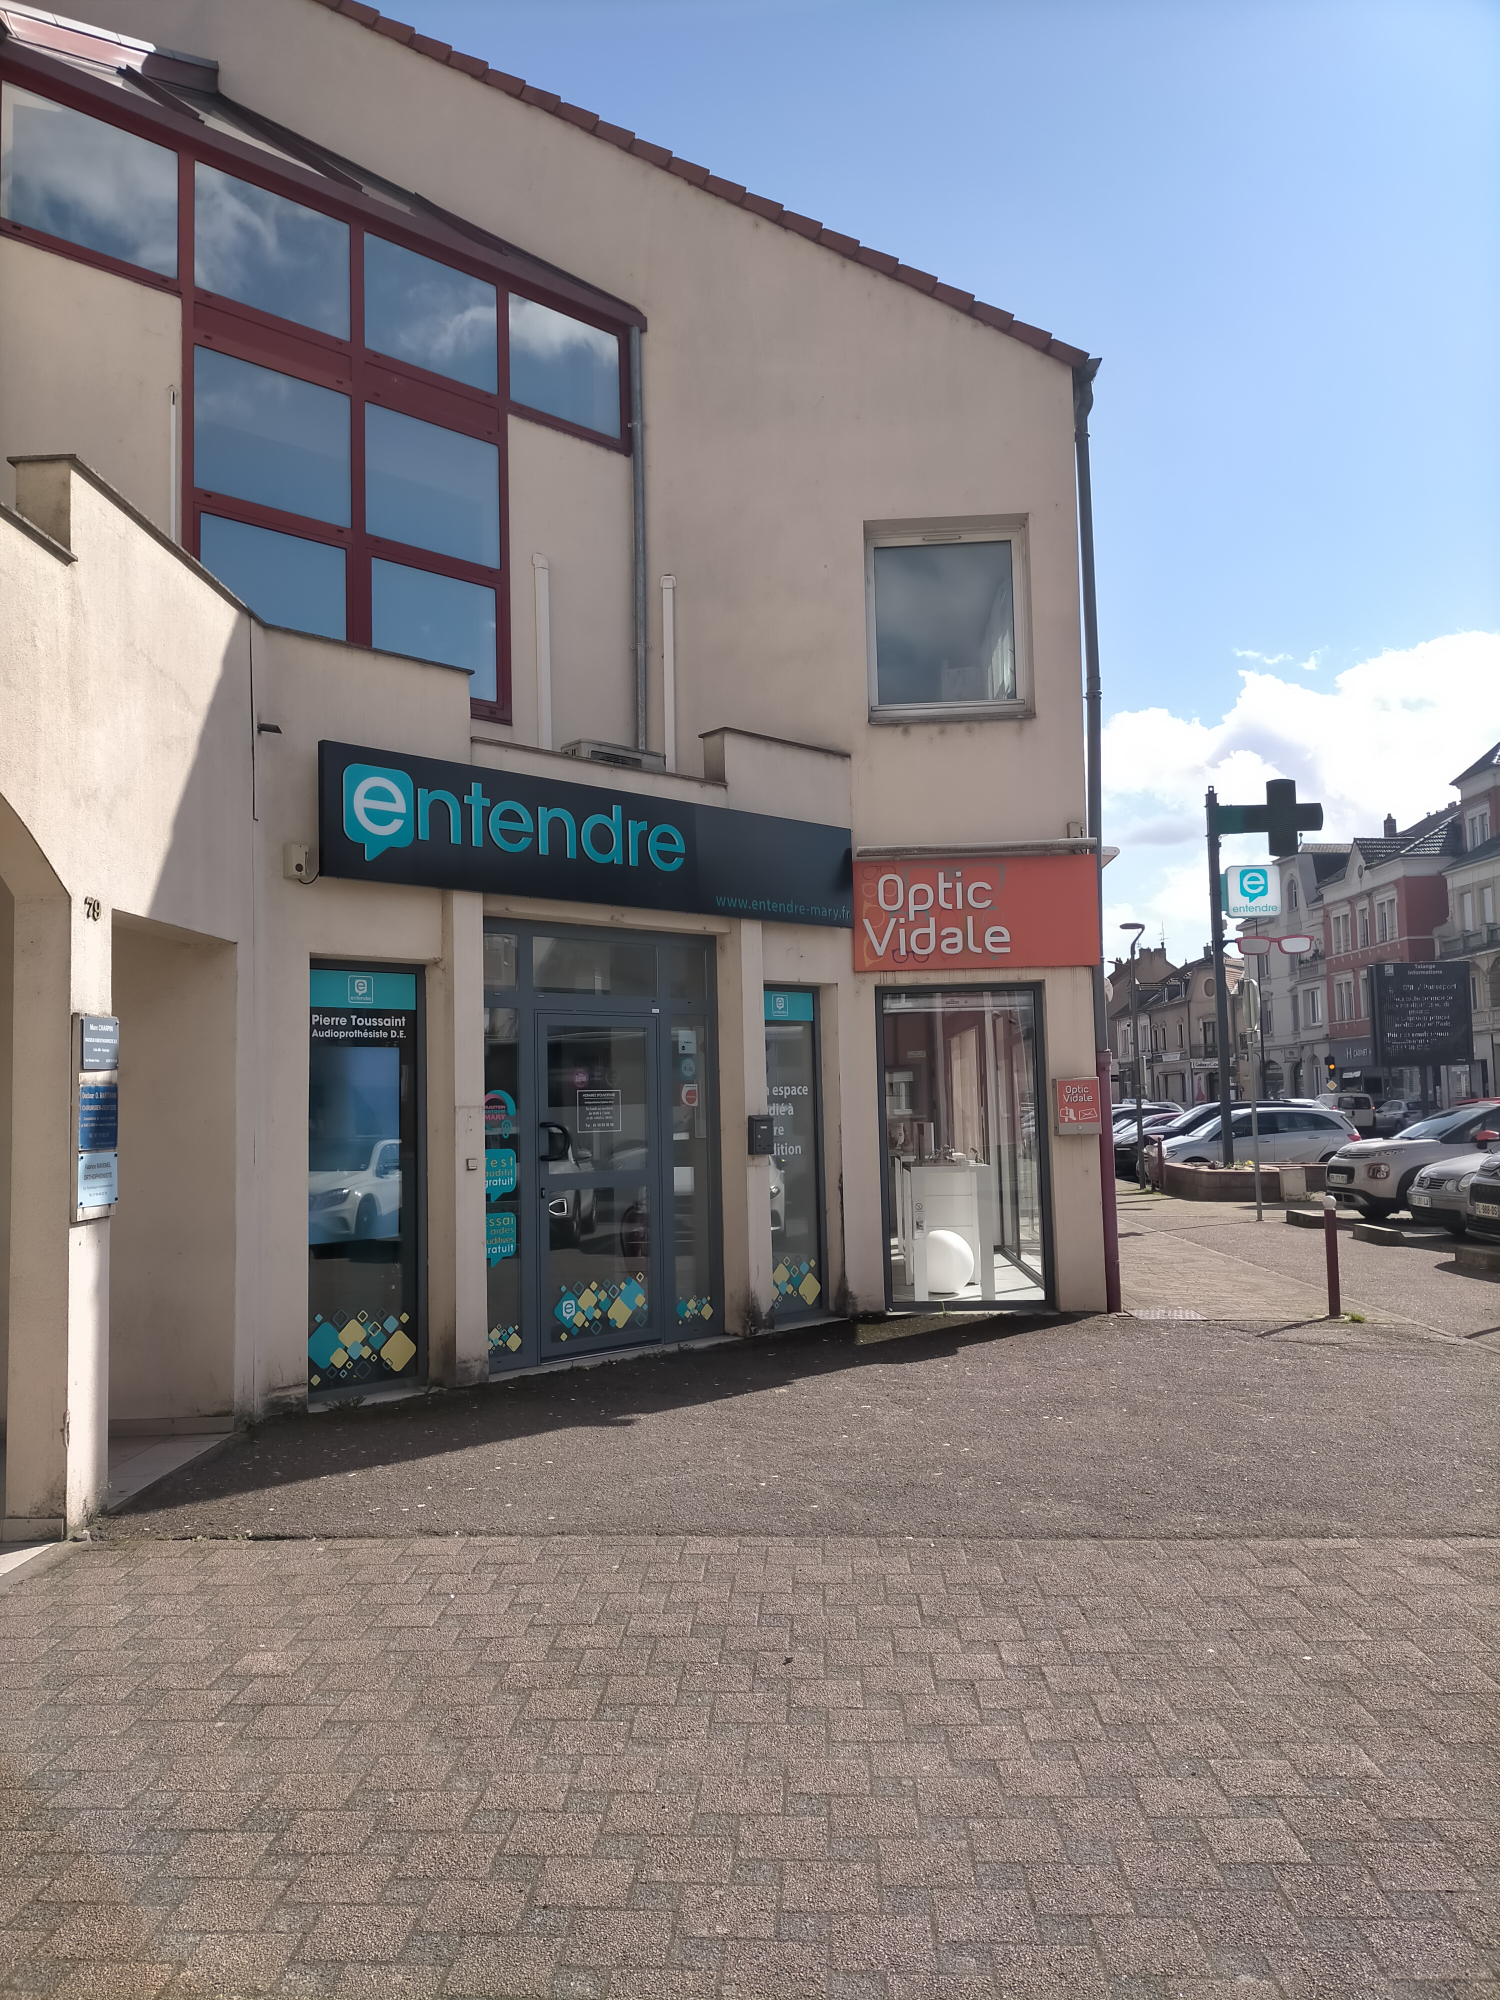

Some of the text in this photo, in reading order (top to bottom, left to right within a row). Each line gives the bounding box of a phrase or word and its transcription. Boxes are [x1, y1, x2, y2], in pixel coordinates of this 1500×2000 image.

[348, 772, 687, 873] entendre
[877, 871, 993, 922] Optic
[84, 896, 101, 921] 79
[715, 896, 850, 921] www.entendre-mary.fr
[1232, 904, 1278, 913] entendre
[862, 916, 1012, 957] Vidale
[311, 1014, 406, 1027] Pierre Toussaint
[311, 1029, 407, 1040] Audioprothésiste D.E.
[772, 1085, 809, 1099] espace
[1065, 1085, 1090, 1095] Optic
[1063, 1093, 1093, 1103] Vidale
[767, 1102, 794, 1116] dié à
[485, 1177, 514, 1188] gratuit
[485, 1216, 514, 1226] ssai
[490, 1227, 515, 1235] aides
[485, 1236, 514, 1245] uditives
[486, 1243, 514, 1254] ratuit
